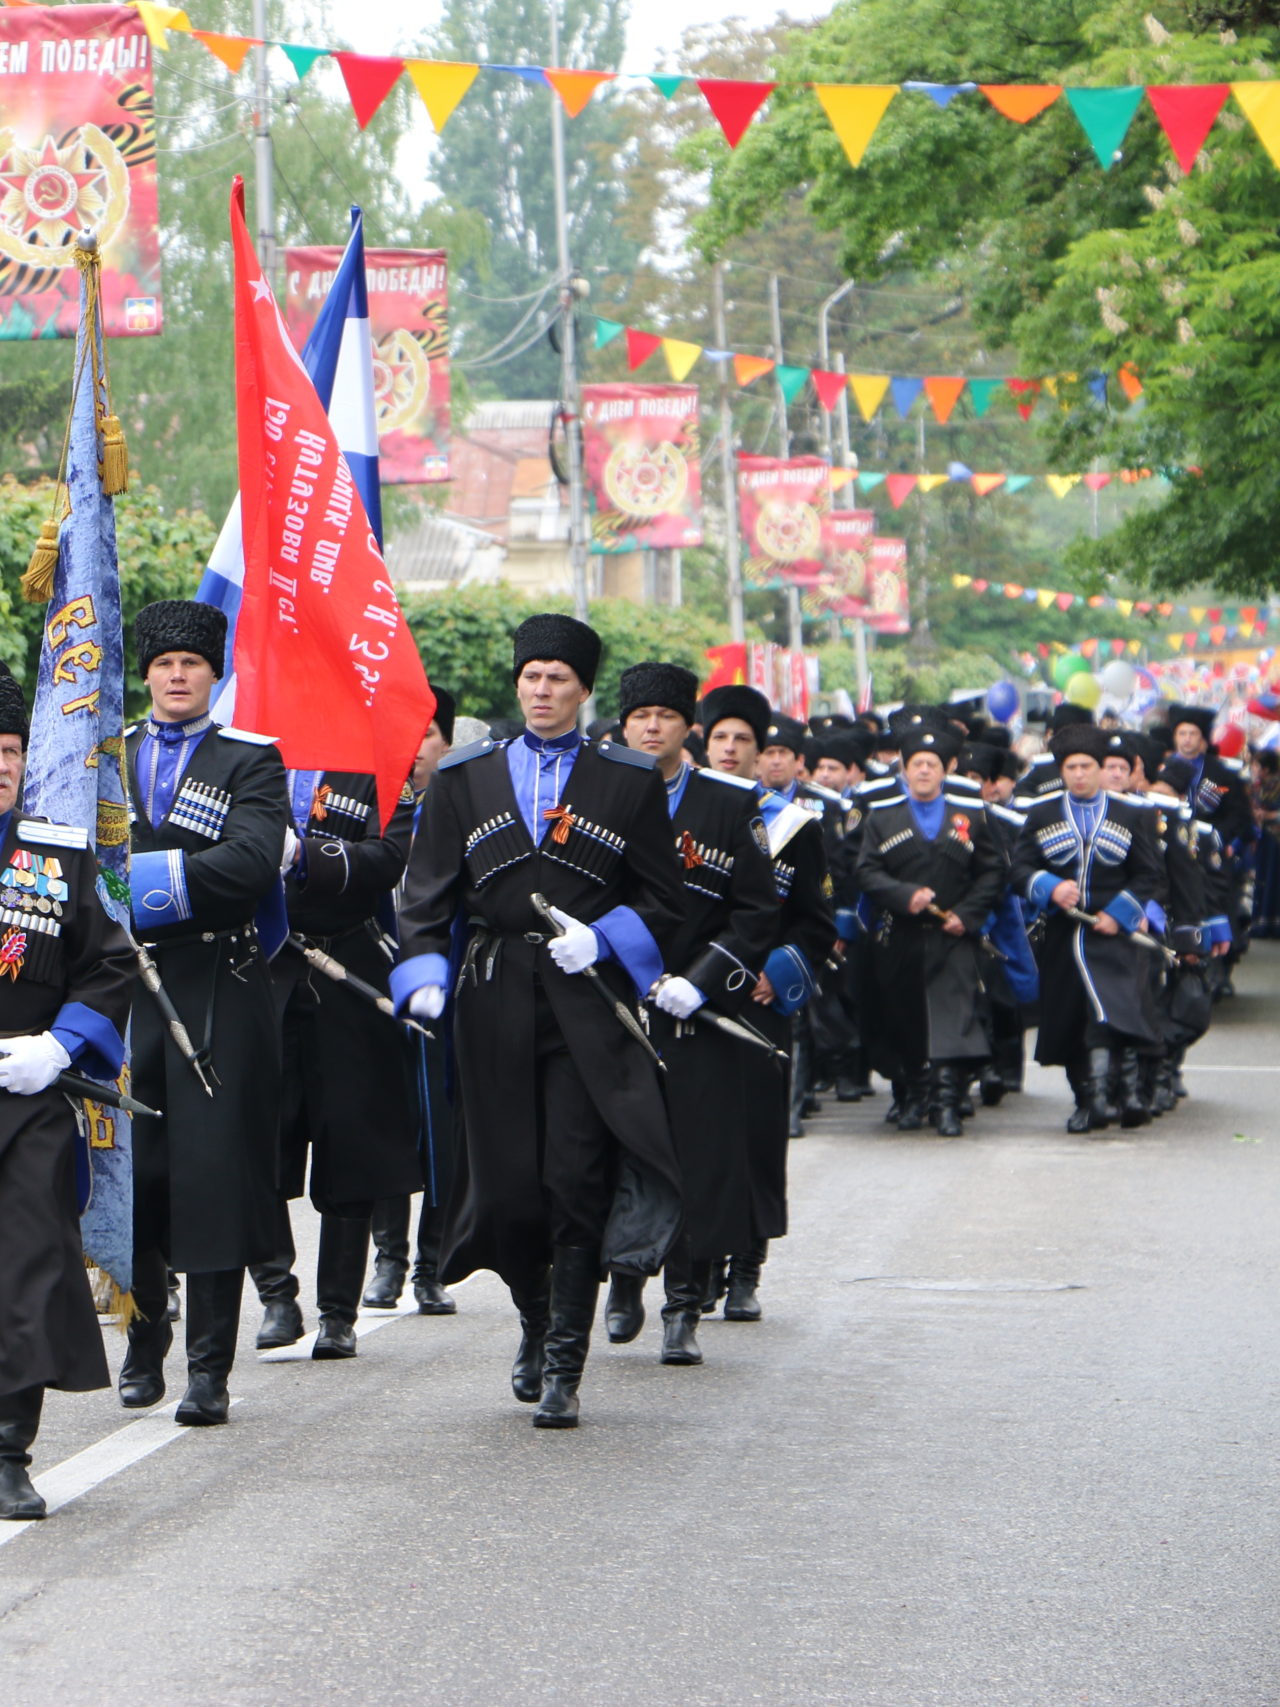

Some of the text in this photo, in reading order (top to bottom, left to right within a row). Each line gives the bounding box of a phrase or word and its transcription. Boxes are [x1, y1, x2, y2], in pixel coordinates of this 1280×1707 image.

[41, 35, 147, 76] ПОБЕДЫ!
[289, 265, 445, 298] С ДН ПОБЕДЫ!
[639, 396, 697, 419] ПОБЕДЫ!
